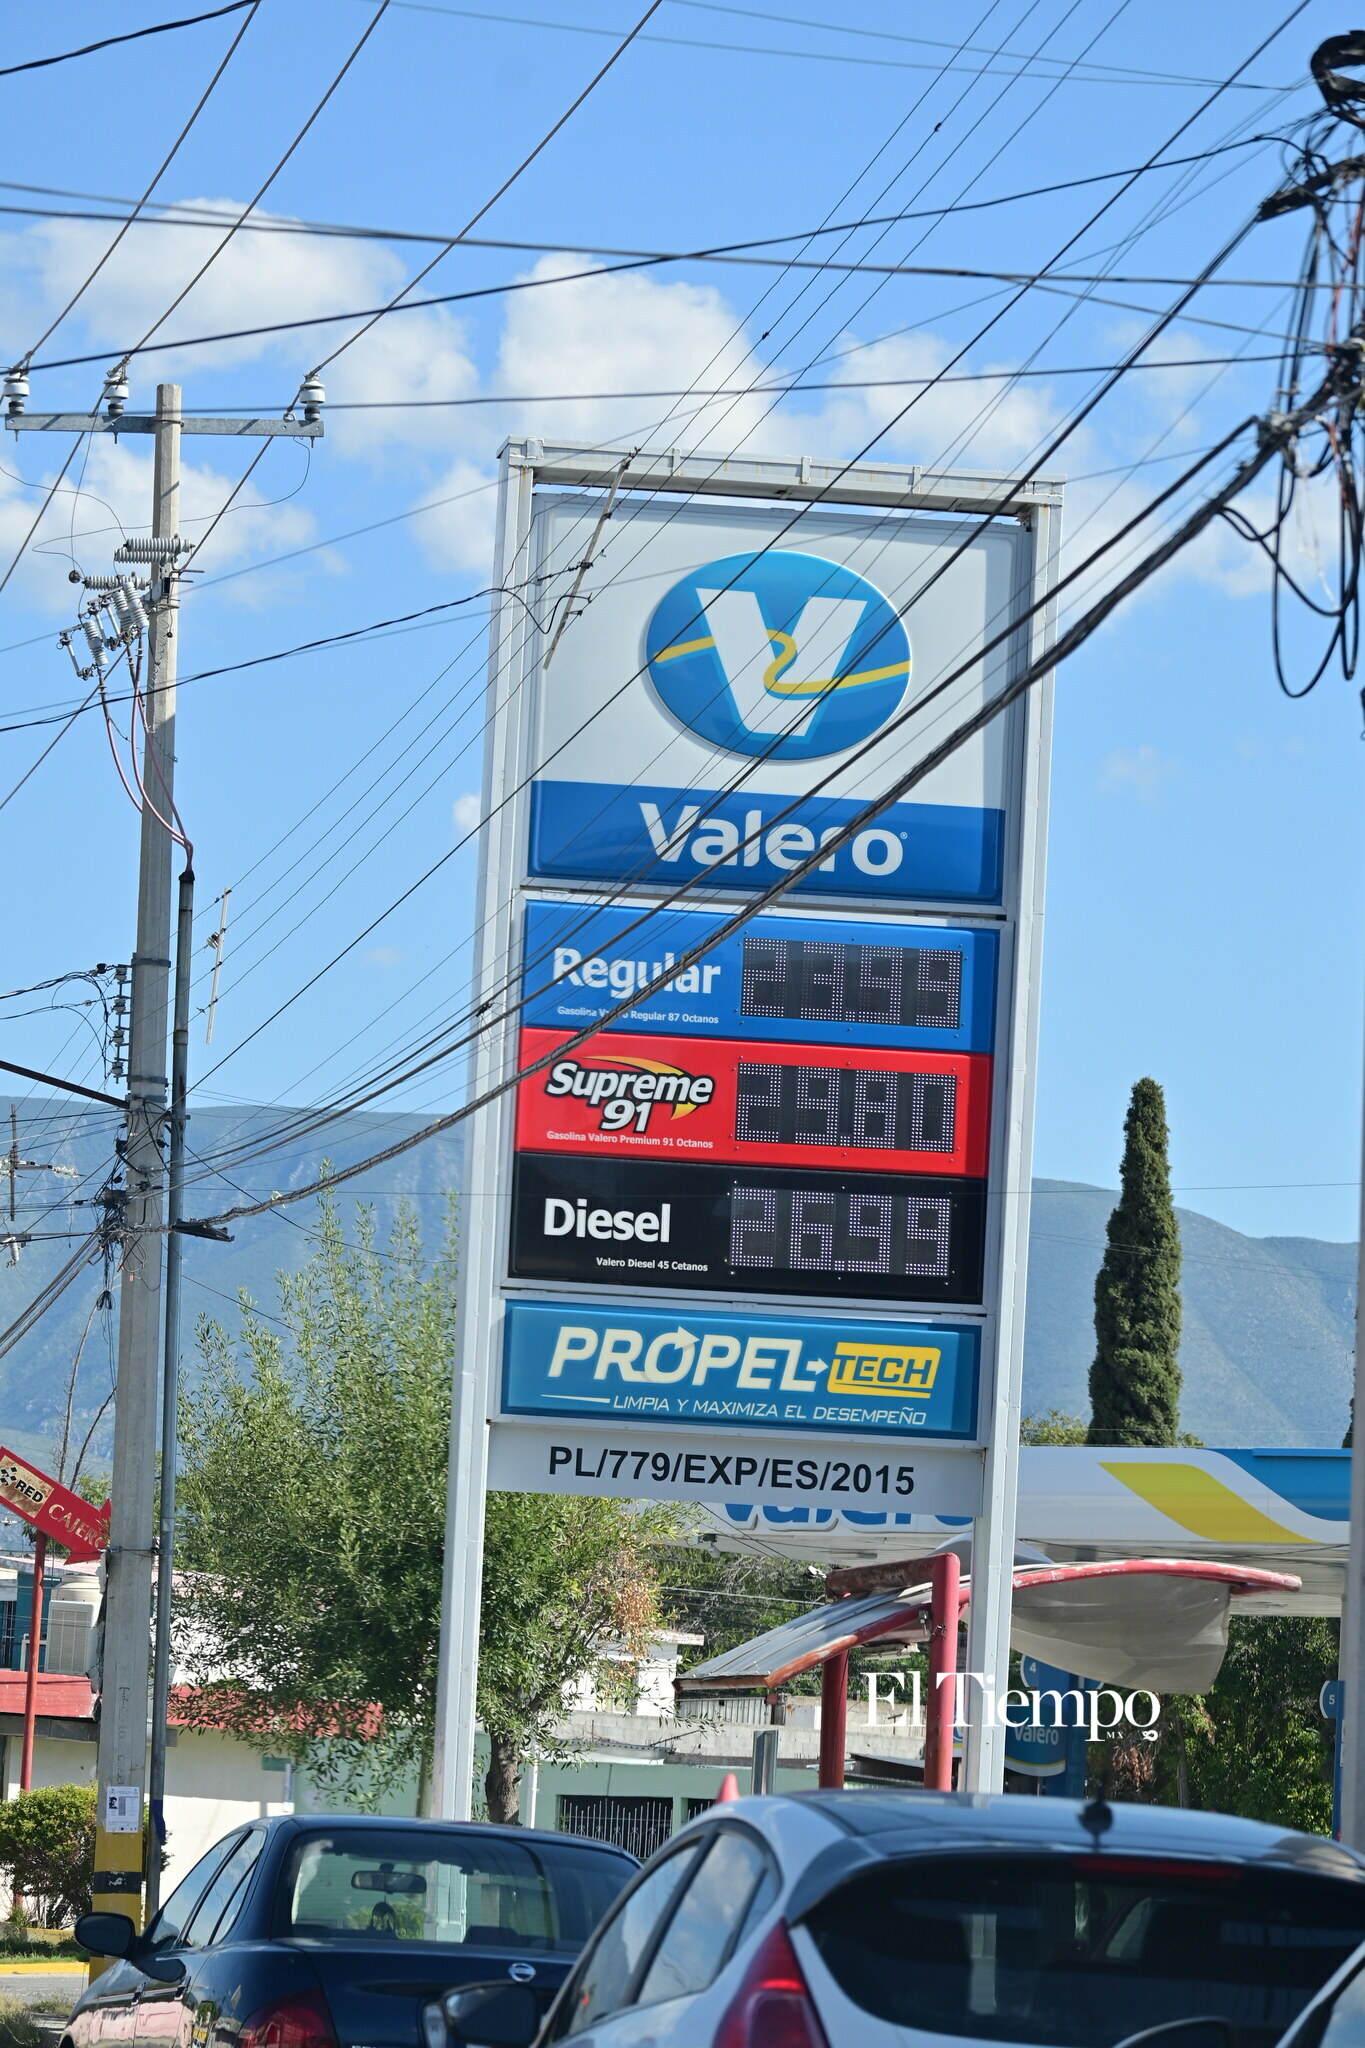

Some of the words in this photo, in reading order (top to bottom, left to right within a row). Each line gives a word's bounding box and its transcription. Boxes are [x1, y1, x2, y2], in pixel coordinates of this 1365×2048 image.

[639, 802, 904, 877] Valero
[553, 947, 721, 999] Regular
[740, 938, 962, 1029] 23.99
[557, 1006, 597, 1017] Gasolina
[631, 1012, 665, 1022] Regular
[668, 1013, 679, 1022] 87
[682, 1014, 719, 1024] Octanos
[546, 1061, 715, 1105] Supreme
[600, 1099, 652, 1133] 91
[735, 1063, 957, 1152] 29.80
[547, 1131, 586, 1142] Gasolina
[588, 1133, 617, 1143] Valero
[620, 1135, 660, 1145] Premium
[663, 1137, 674, 1146] 91
[676, 1138, 713, 1148] Octanos
[544, 1198, 671, 1243] Diesel
[731, 1188, 951, 1276] 26.99
[596, 1257, 625, 1267] Valero
[627, 1258, 655, 1268] Diesel
[658, 1260, 669, 1269] 45
[671, 1261, 708, 1272] Cetanos
[547, 1326, 817, 1393] PROPEL
[834, 1353, 933, 1387] TECH
[613, 1395, 670, 1412] LIMPIA
[677, 1399, 689, 1412] Y
[693, 1400, 779, 1418] MAXIMIZA
[784, 1405, 806, 1419] EL
[813, 1406, 926, 1425] DESEMPEÑO
[15, 1479, 44, 1503] RED
[549, 1446, 915, 1495] PL/779/EXP/ES/2015
[1029, 1662, 1037, 1673] 4
[1328, 1694, 1335, 1705] 5
